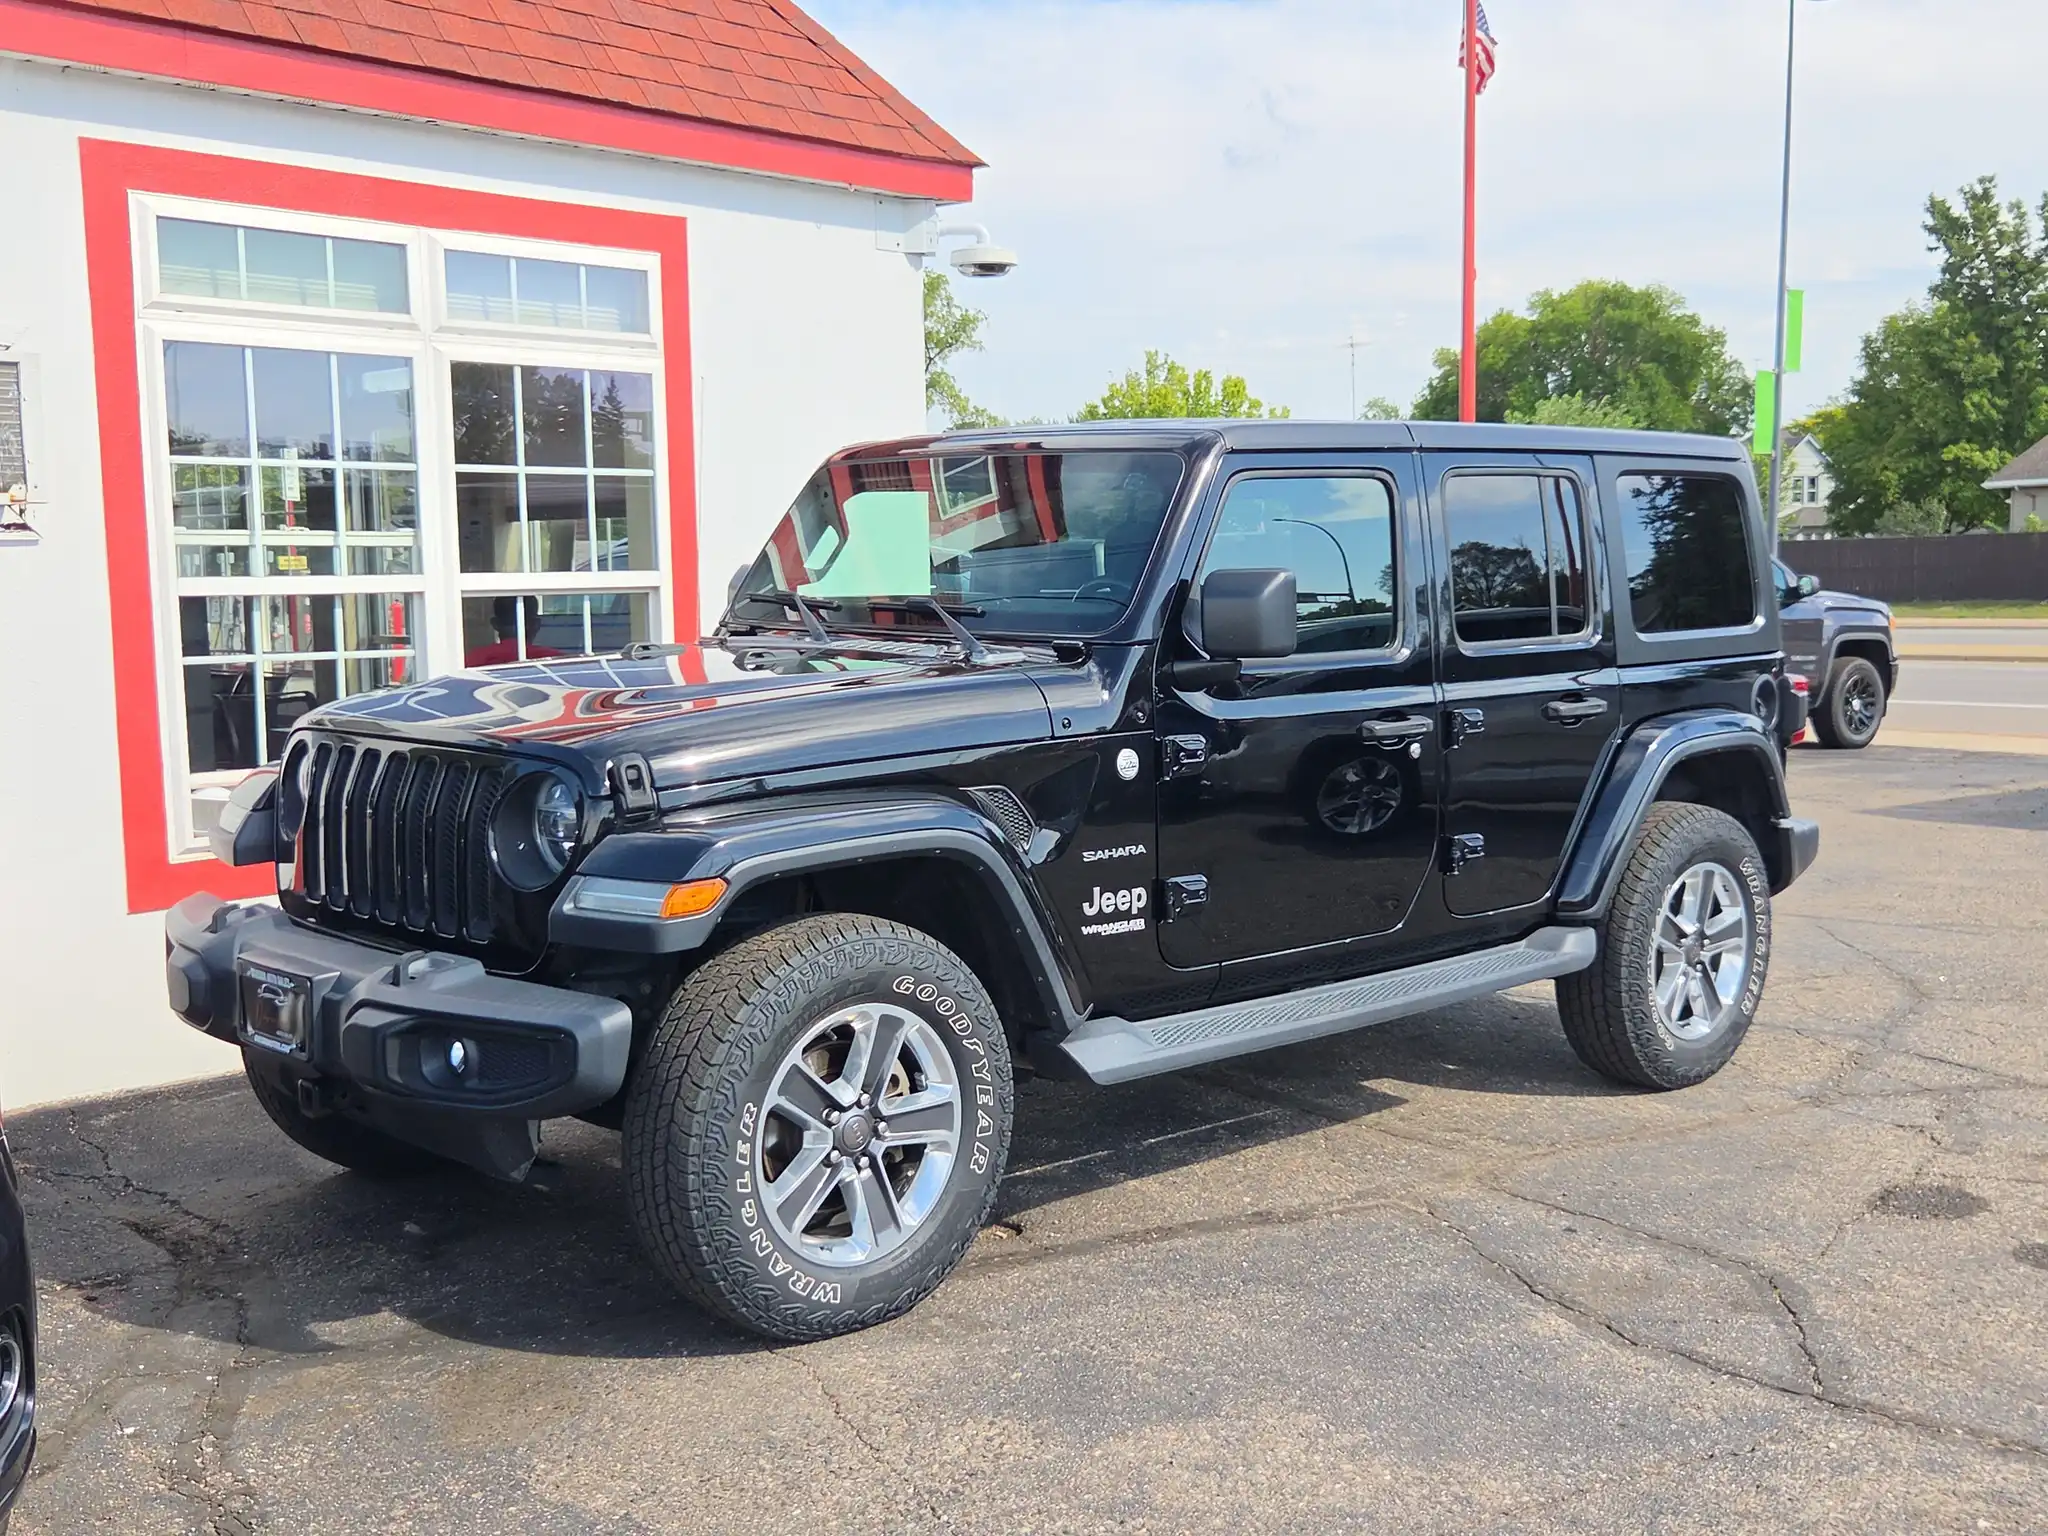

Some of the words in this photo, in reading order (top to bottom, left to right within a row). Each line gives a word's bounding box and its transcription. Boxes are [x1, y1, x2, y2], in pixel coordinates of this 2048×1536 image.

[1082, 844, 1146, 862] SAHARA
[1082, 886, 1147, 916] Jeep
[1739, 857, 1766, 1016] WRANGLER
[893, 975, 994, 1175] GOODYEAR
[736, 1101, 841, 1304] WRANGLER
